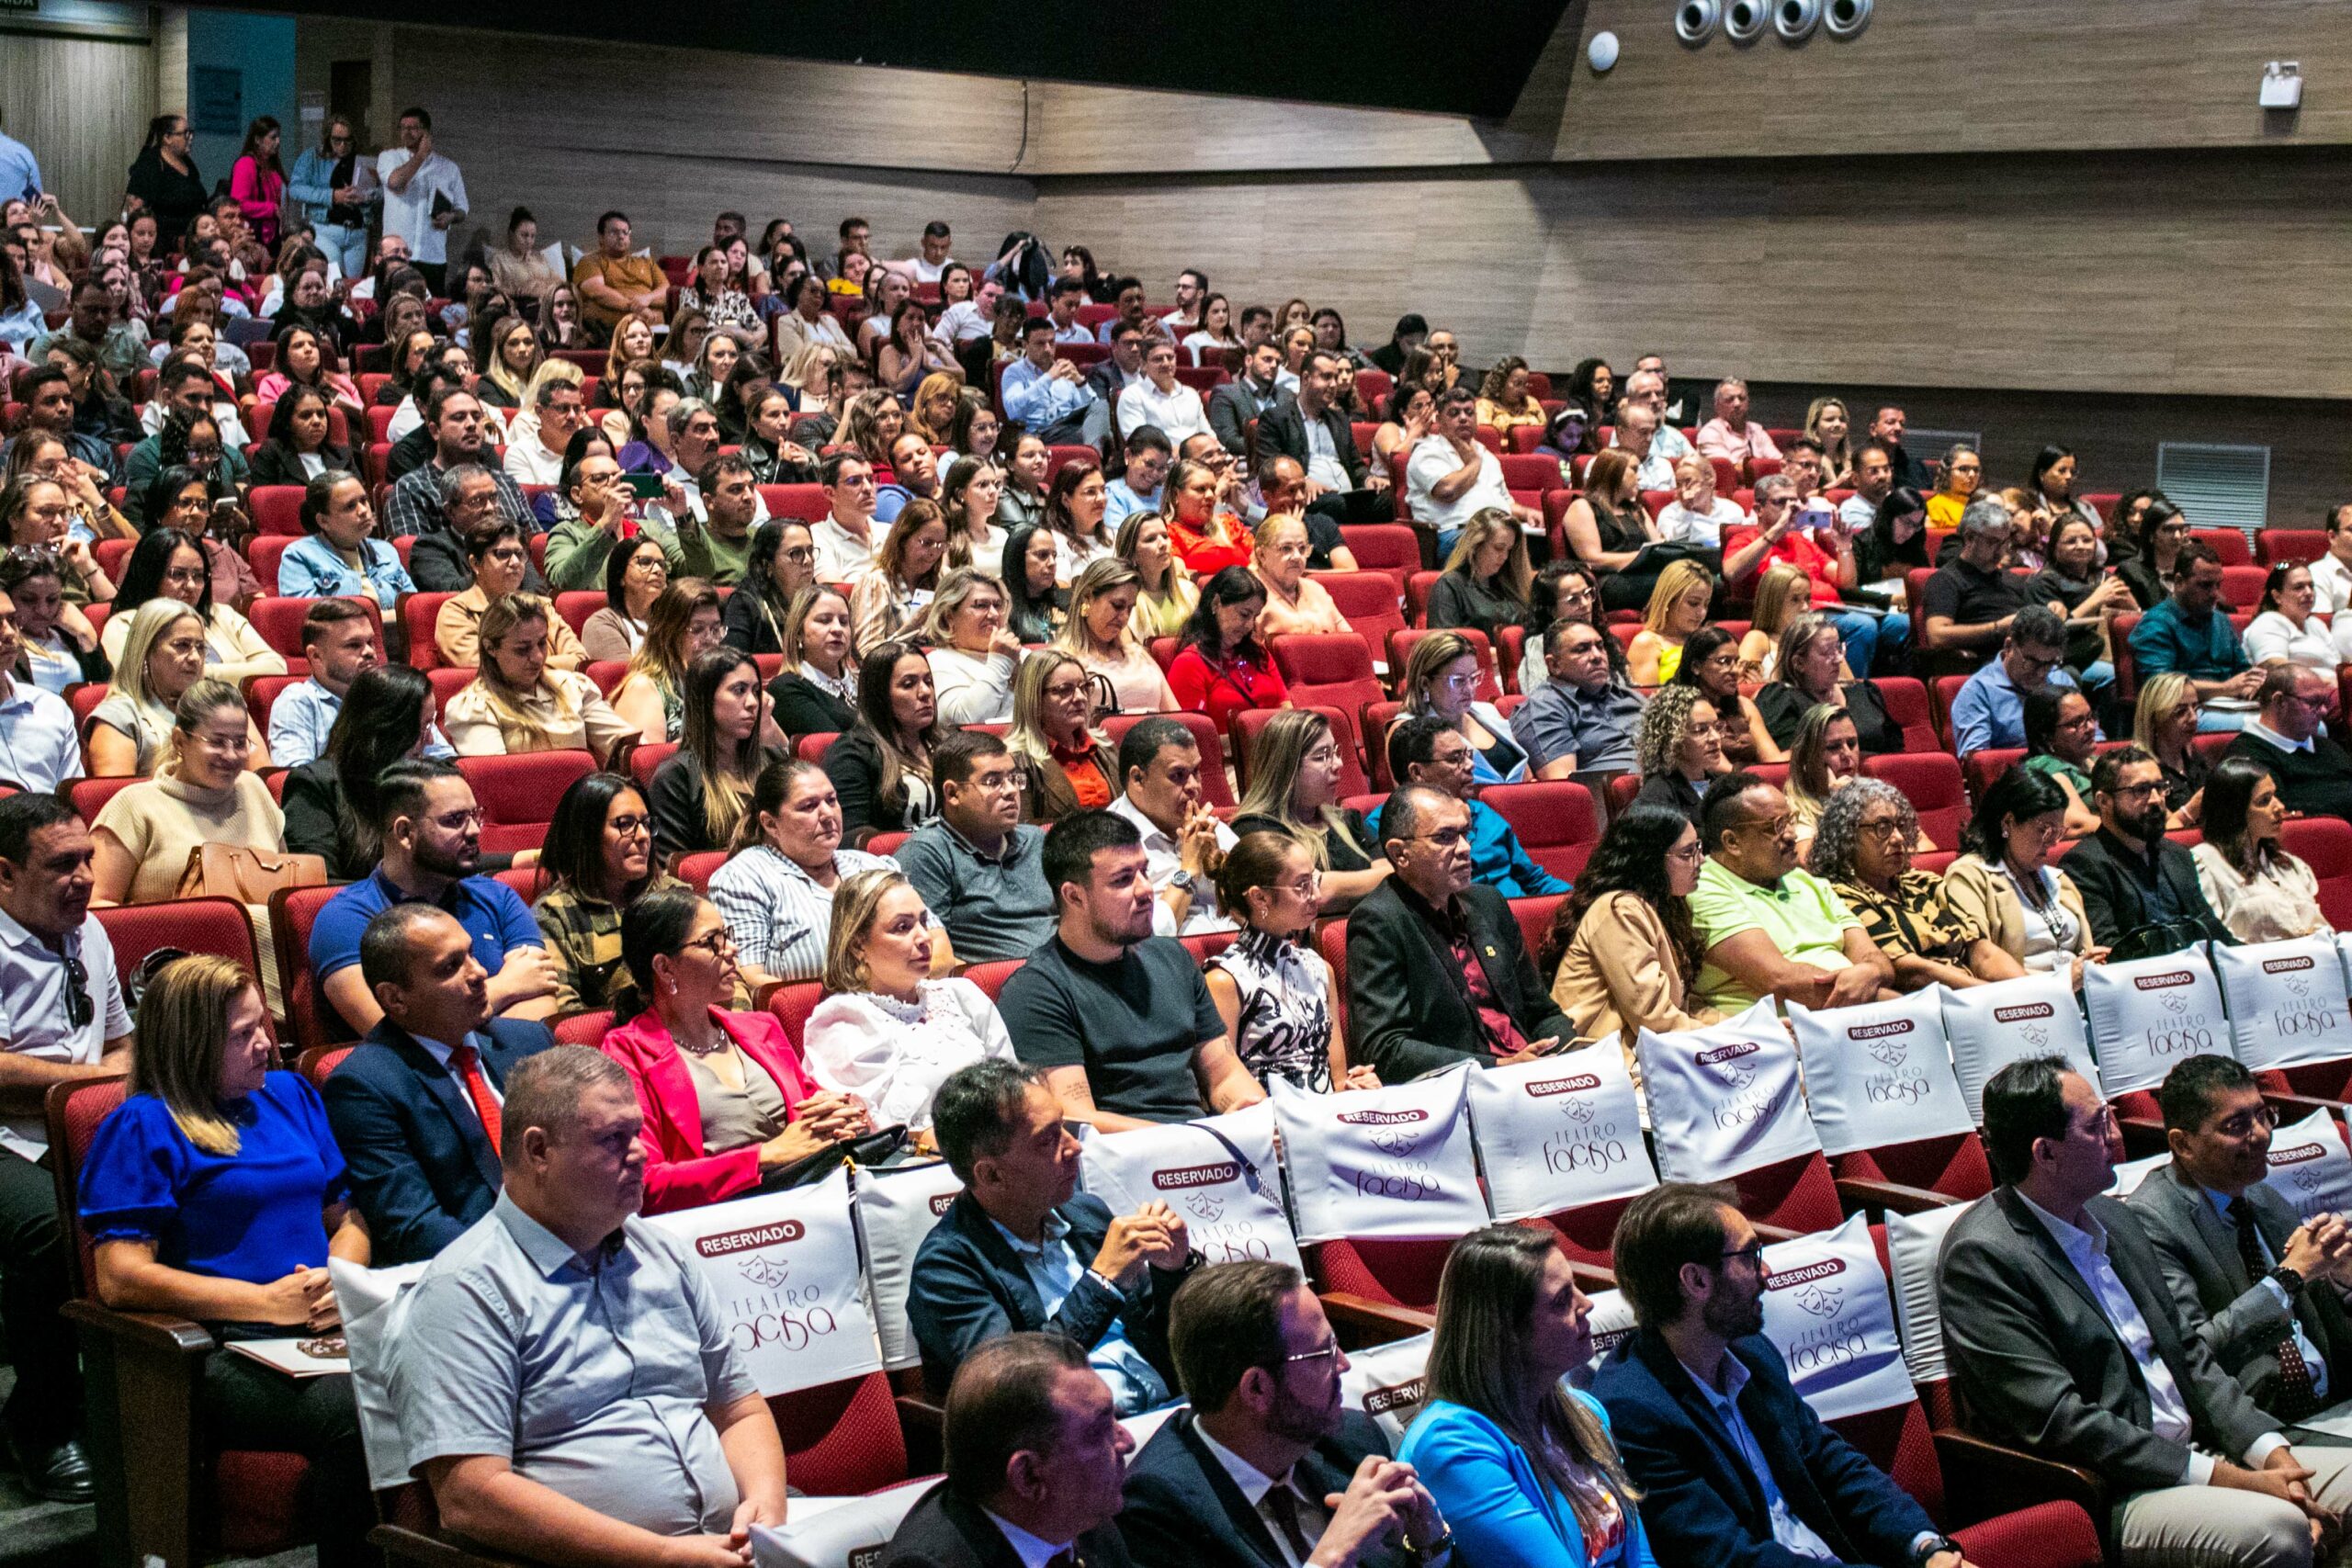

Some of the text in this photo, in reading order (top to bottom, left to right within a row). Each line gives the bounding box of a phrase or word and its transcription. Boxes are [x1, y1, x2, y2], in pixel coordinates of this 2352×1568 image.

[2265, 958, 2311, 972] RESERVADO
[2137, 973, 2190, 988] RESERVADO
[1996, 1005, 2050, 1021] RESERVADO
[1851, 1021, 1908, 1038] RESERVADO
[1701, 1043, 1756, 1064] RESERVADO
[1529, 1076, 1595, 1095] RESERVADO
[1343, 1111, 1420, 1124] RESERVADO
[2267, 1145, 2322, 1163] RESERVADO
[1158, 1166, 1233, 1187] RESERVADO
[701, 1224, 797, 1254] RESERVADO
[1767, 1262, 1838, 1289] RESERVADO
[732, 1285, 820, 1317] TEATRO
[732, 1307, 837, 1352] acisa
[1368, 1382, 1427, 1411] RESERVA
